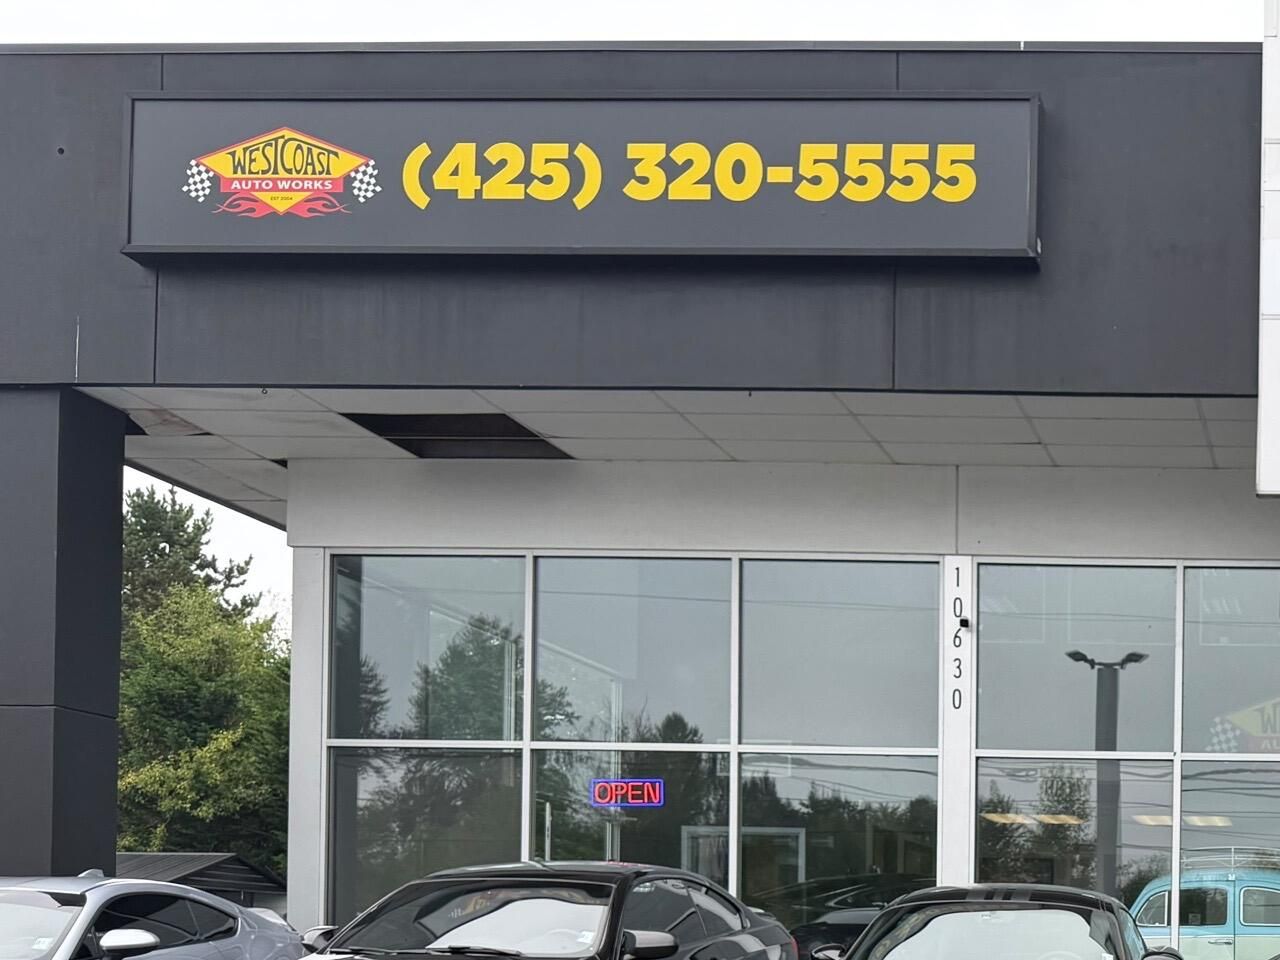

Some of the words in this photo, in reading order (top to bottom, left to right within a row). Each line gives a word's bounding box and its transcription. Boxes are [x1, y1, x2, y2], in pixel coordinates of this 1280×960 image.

[231, 180, 273, 190] AUTO
[276, 180, 333, 190] WORKS
[403, 143, 603, 209] (425)
[623, 143, 978, 204] 320-5555
[594, 782, 660, 804] OPEN
